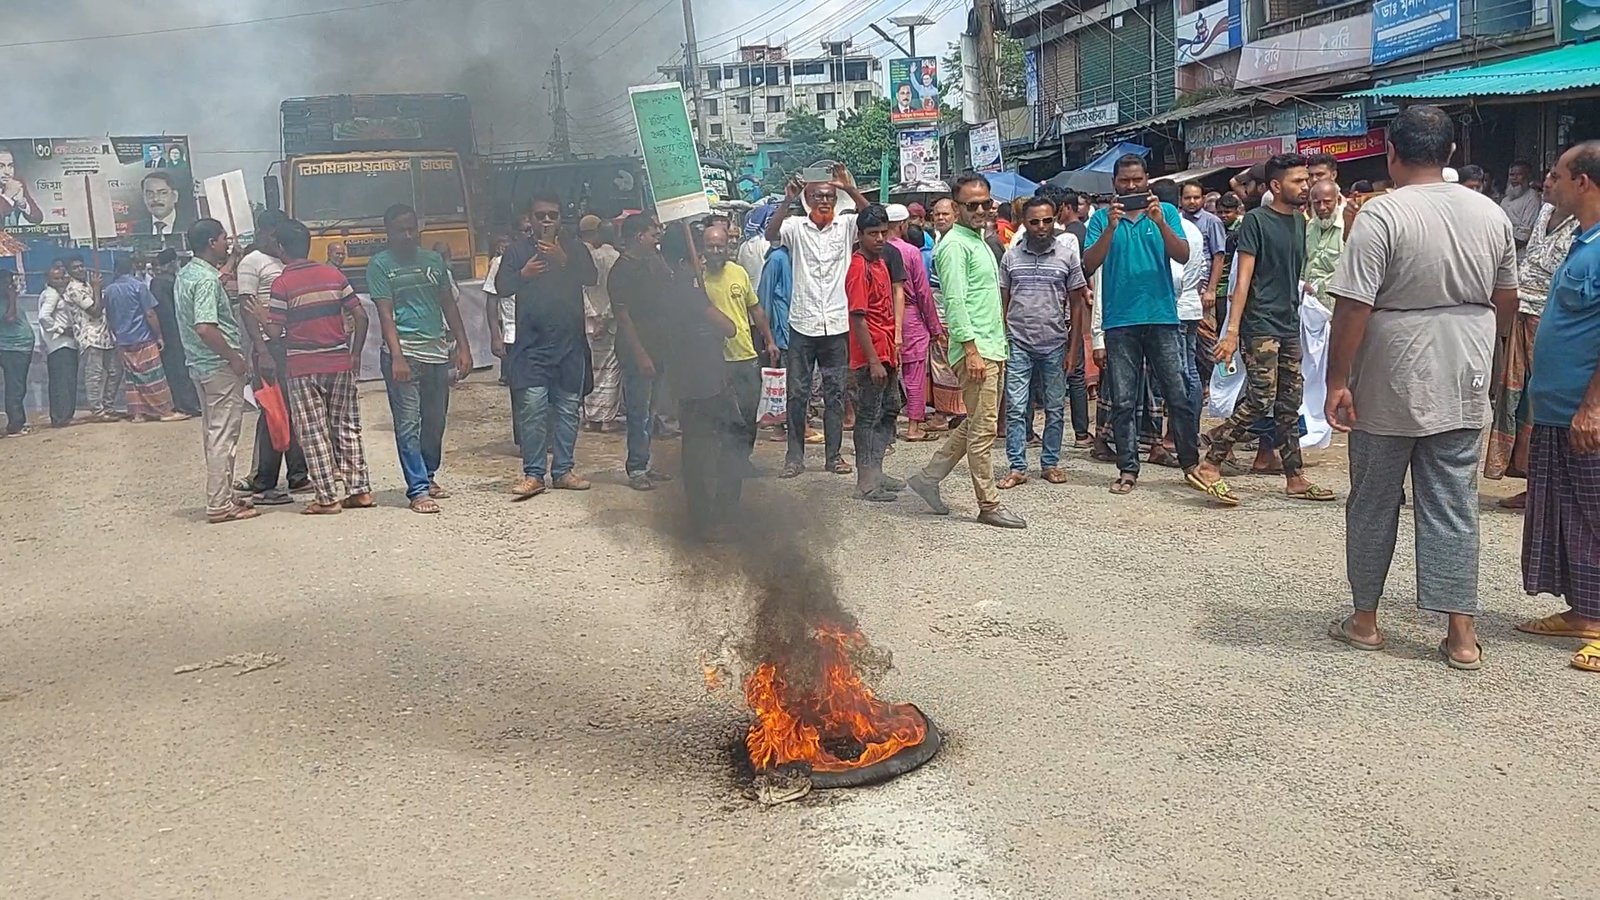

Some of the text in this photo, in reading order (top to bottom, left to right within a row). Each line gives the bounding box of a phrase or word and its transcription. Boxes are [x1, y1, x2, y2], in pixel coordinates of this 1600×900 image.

[1381, 2, 1398, 18] ডাঃ
[1331, 25, 1350, 50] রবি
[1264, 41, 1281, 66] রবি
[36, 144, 51, 157] ৩০
